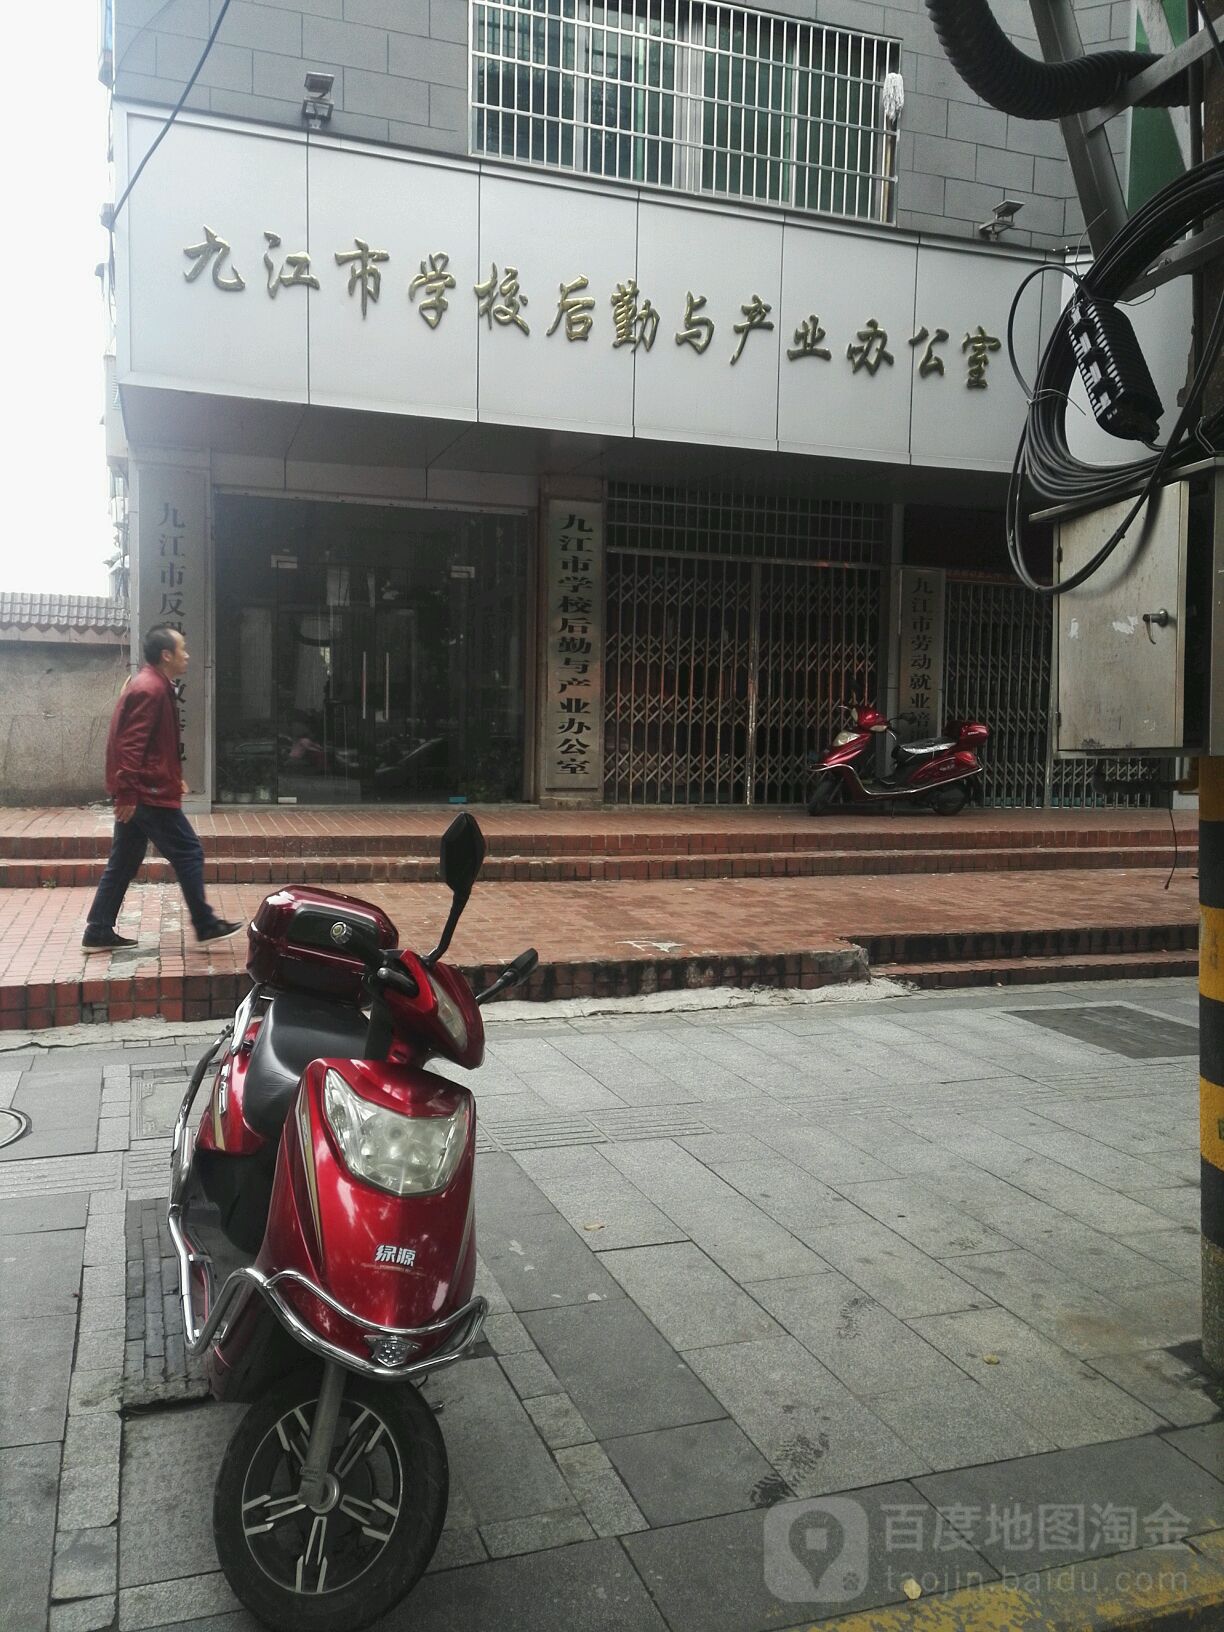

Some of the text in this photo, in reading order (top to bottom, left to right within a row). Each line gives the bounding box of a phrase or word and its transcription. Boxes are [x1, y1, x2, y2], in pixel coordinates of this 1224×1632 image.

[183, 225, 1001, 389] 九江市学校后勤与产业办公室
[556, 513, 594, 775] 九江市学校后勤与产业办公室
[375, 1245, 416, 1267] 绿源
